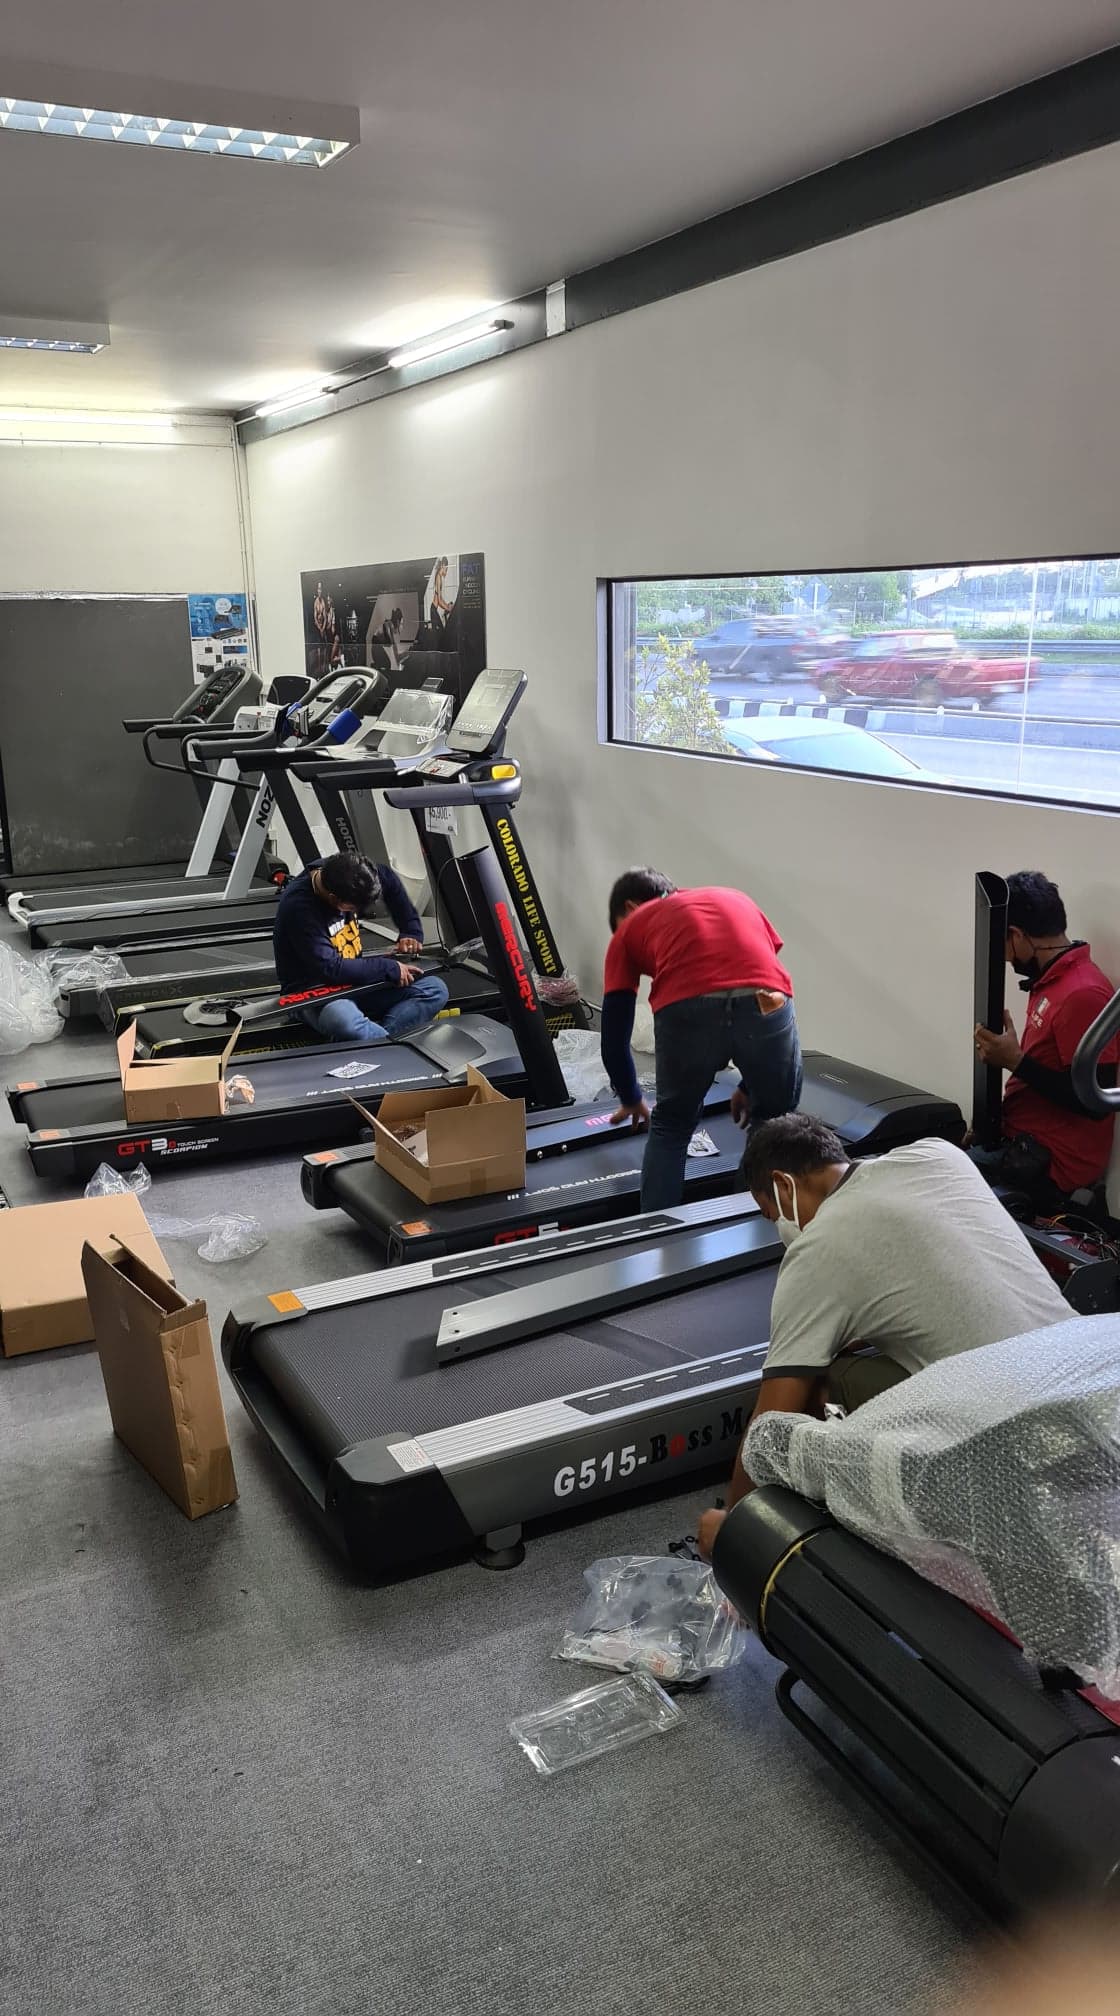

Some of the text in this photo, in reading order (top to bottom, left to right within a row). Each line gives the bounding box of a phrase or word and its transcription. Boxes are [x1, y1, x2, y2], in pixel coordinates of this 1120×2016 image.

[494, 901, 537, 1012] MERCURY
[496, 818, 557, 974] COLORADO LIFE SPORT
